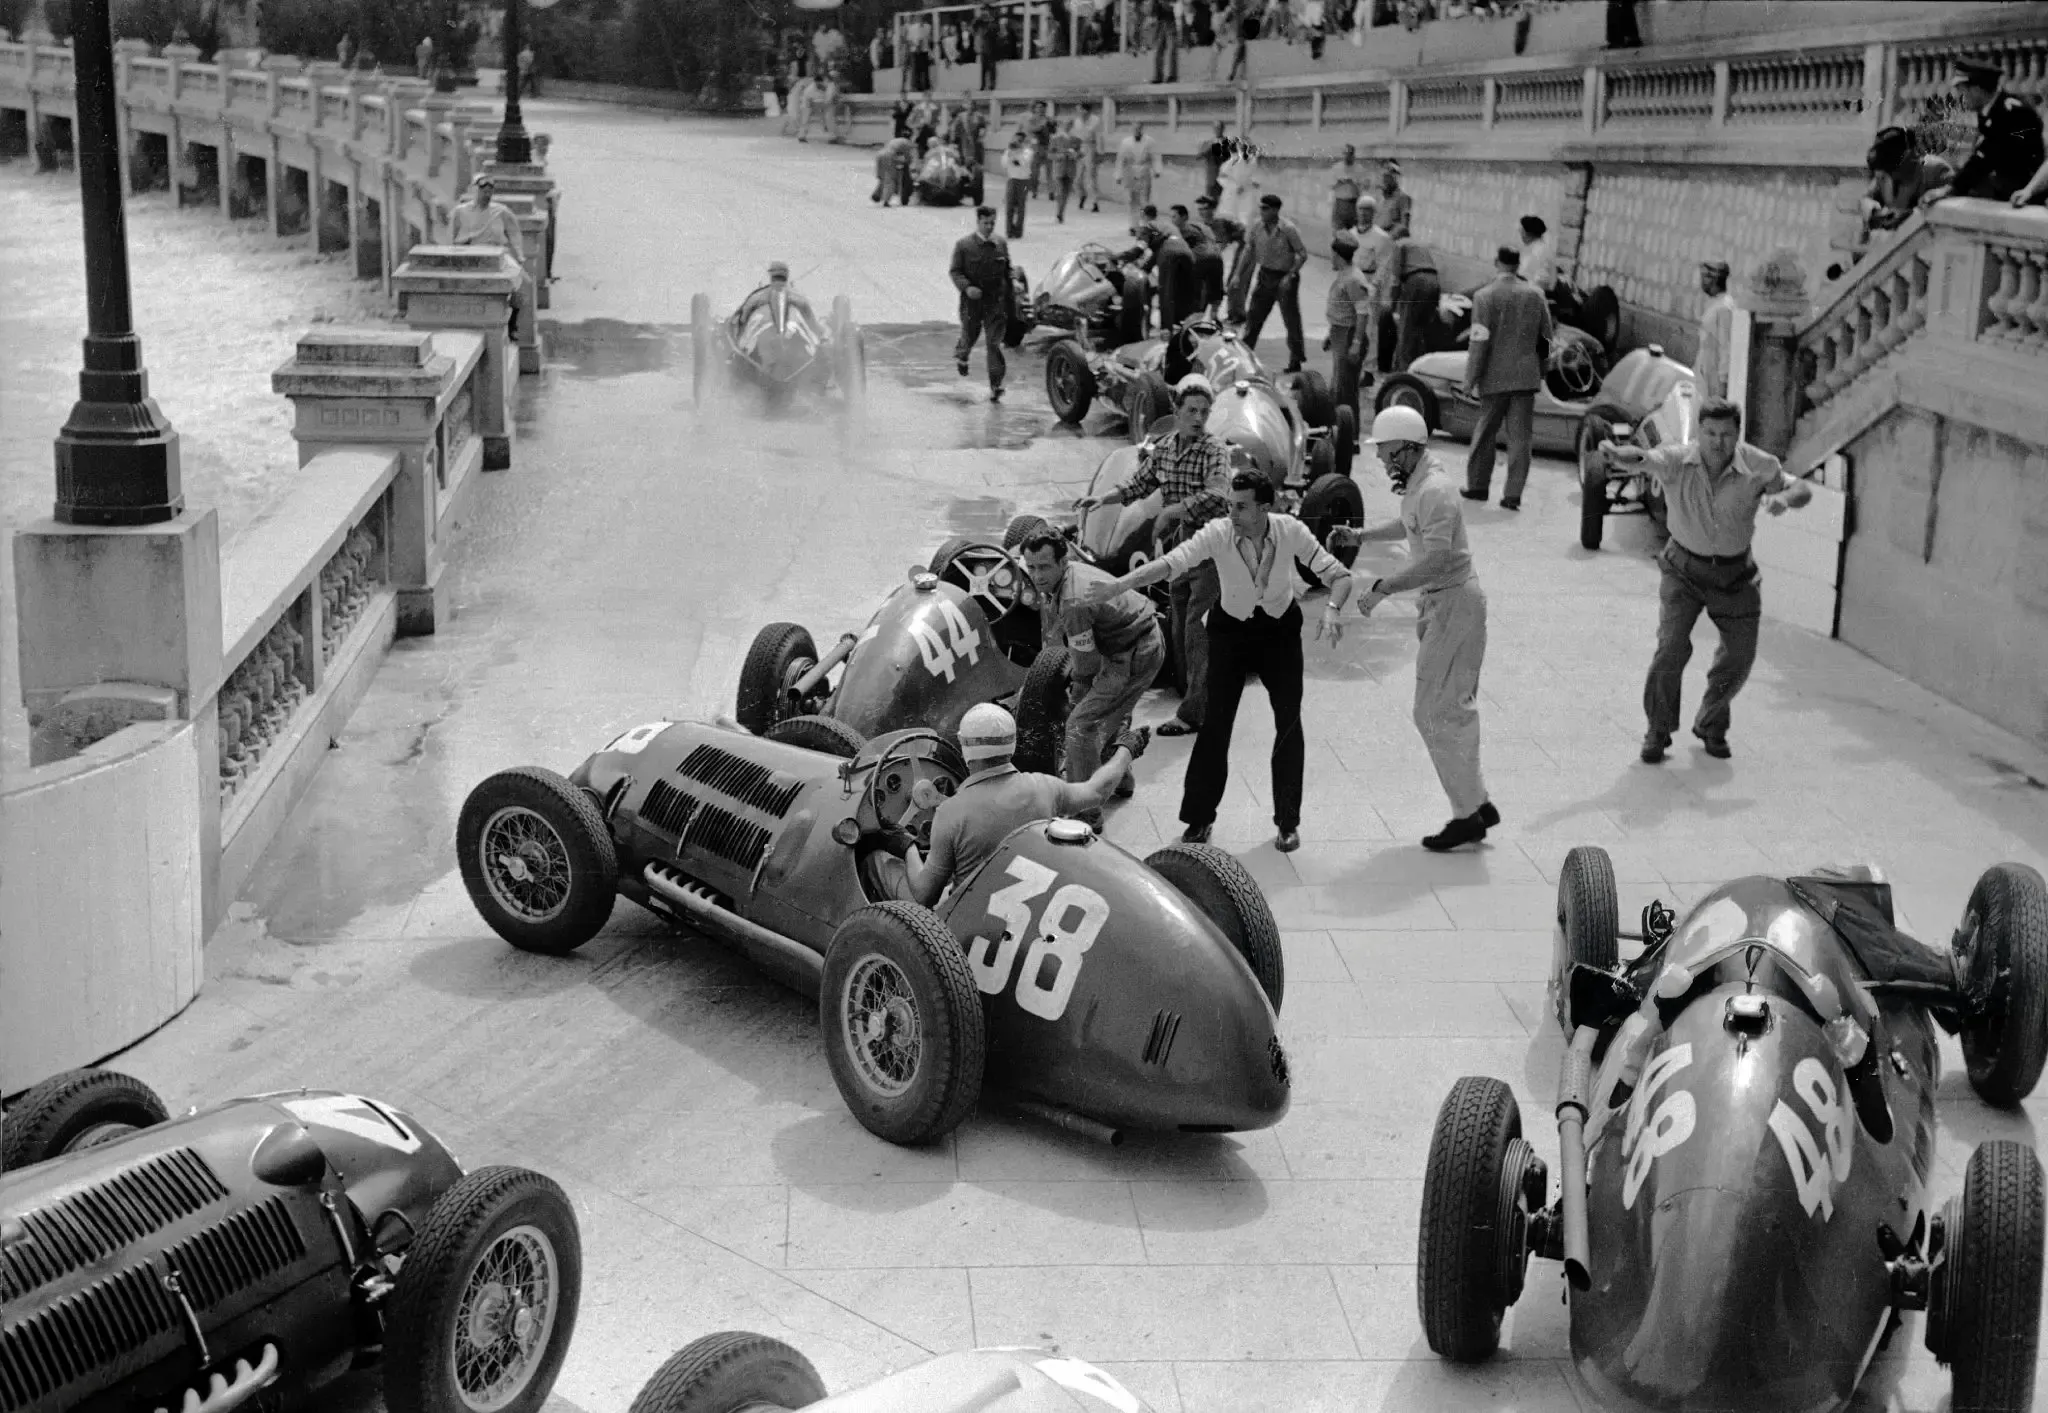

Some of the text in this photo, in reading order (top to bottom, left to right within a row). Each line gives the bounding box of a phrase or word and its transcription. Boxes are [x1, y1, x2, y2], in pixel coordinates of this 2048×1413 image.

[908, 599, 981, 685] 44
[967, 854, 1110, 1021] 38
[1622, 1042, 1697, 1210] 48
[1767, 1057, 1855, 1223] 48
